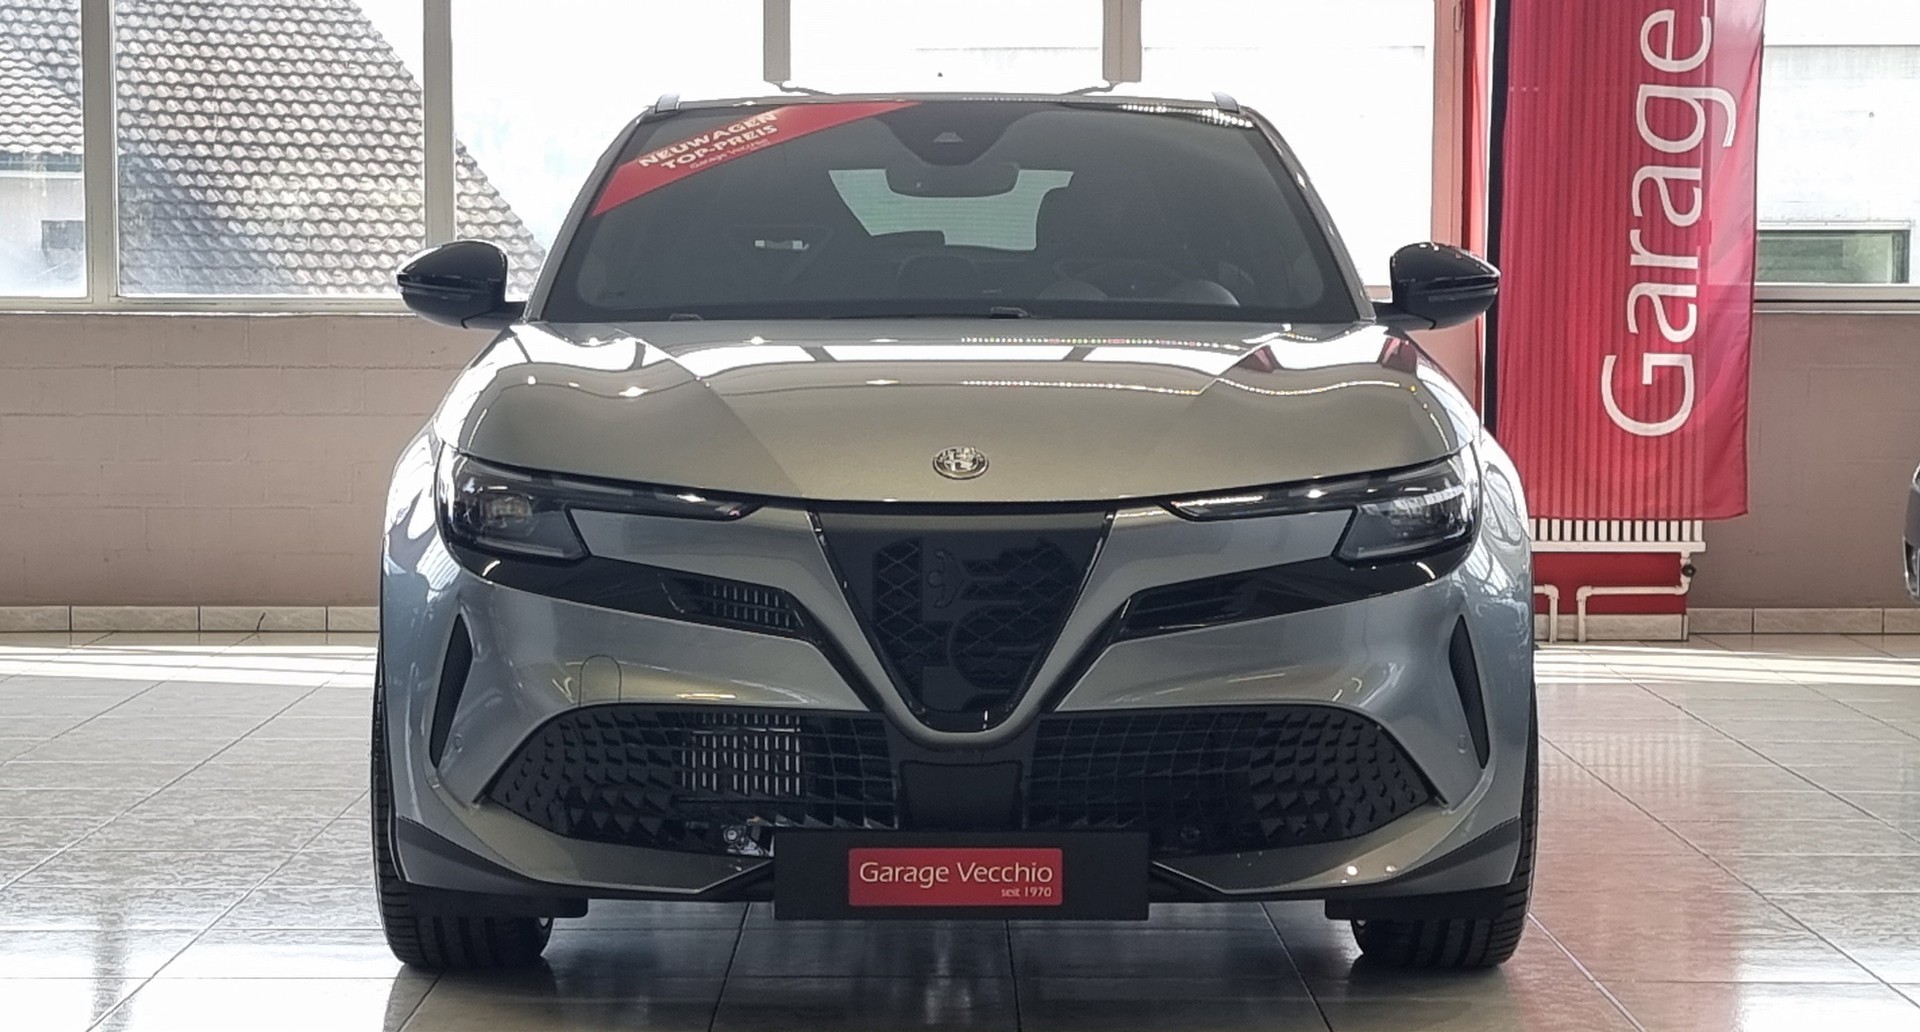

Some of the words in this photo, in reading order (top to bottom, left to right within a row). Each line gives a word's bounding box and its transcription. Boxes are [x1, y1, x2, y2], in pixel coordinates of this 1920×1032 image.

[639, 111, 778, 167] NEUWAGEN
[660, 124, 778, 169] TOP-PREIS
[1601, 8, 1738, 437] Garage
[860, 861, 950, 889] Garage
[956, 861, 1053, 883] Vecchio
[1001, 888, 1021, 898] seit
[1024, 886, 1052, 898] 1970
